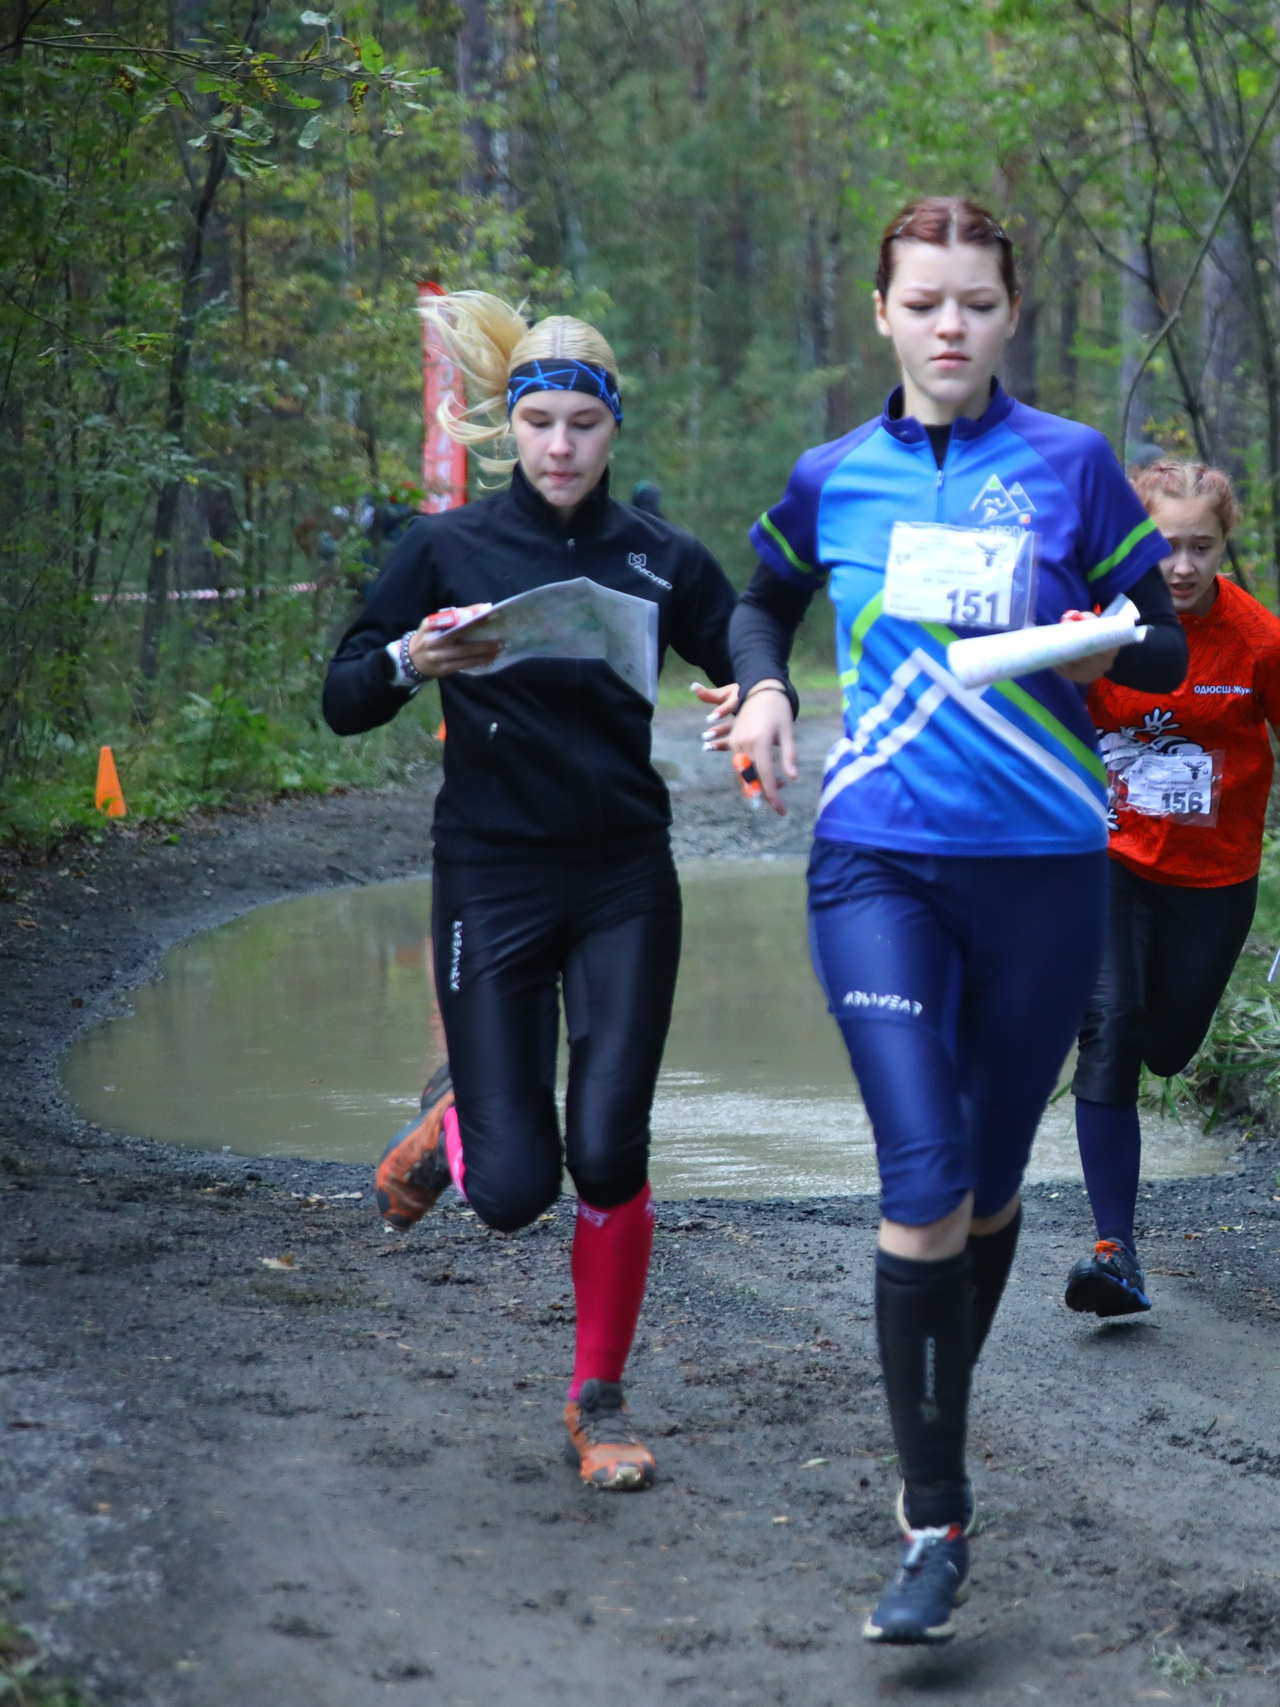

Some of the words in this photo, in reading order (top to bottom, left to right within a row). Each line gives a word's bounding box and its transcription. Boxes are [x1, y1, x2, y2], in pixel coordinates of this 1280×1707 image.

[633, 564, 673, 590] NORD
[946, 589, 1000, 623] 151
[1161, 791, 1203, 813] 156
